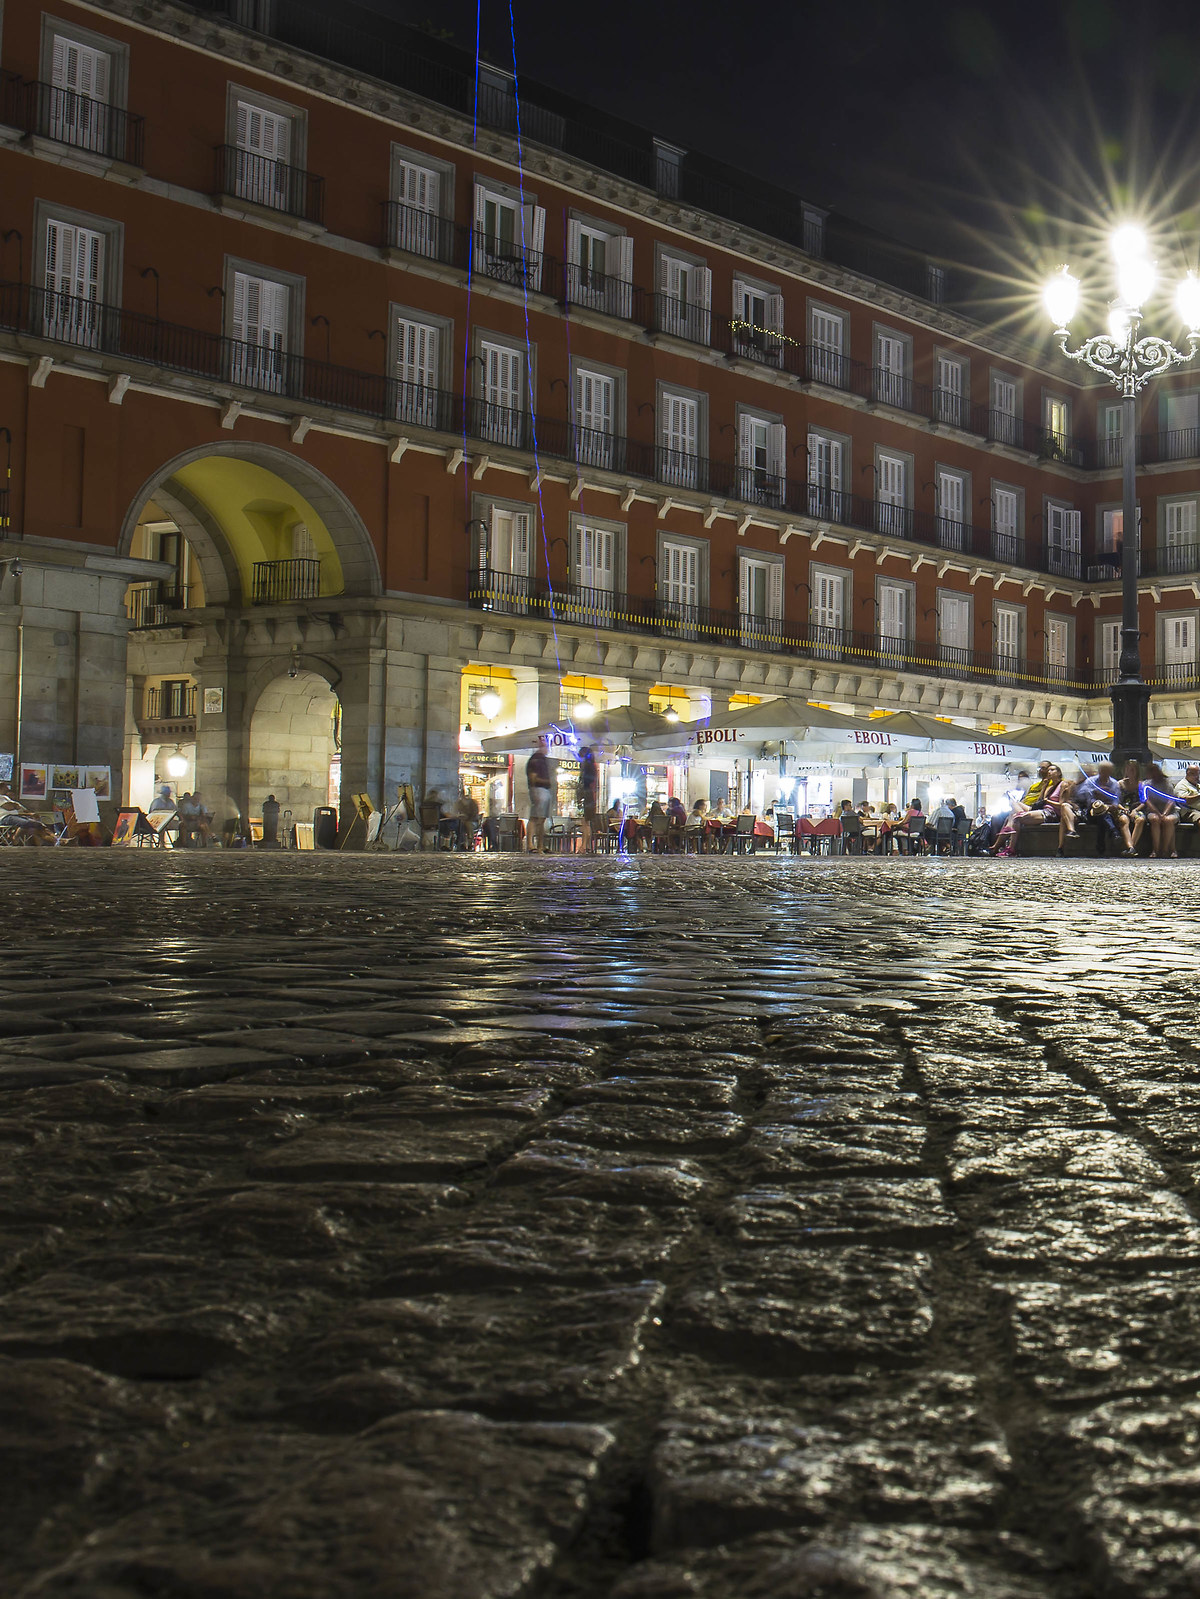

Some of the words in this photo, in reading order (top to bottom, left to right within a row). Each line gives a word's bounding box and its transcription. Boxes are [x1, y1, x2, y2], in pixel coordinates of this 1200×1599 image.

[538, 733, 576, 749] EOL
[696, 728, 738, 745] EBOLI
[854, 731, 892, 746] EBOLI
[974, 743, 1006, 757] EBOLI
